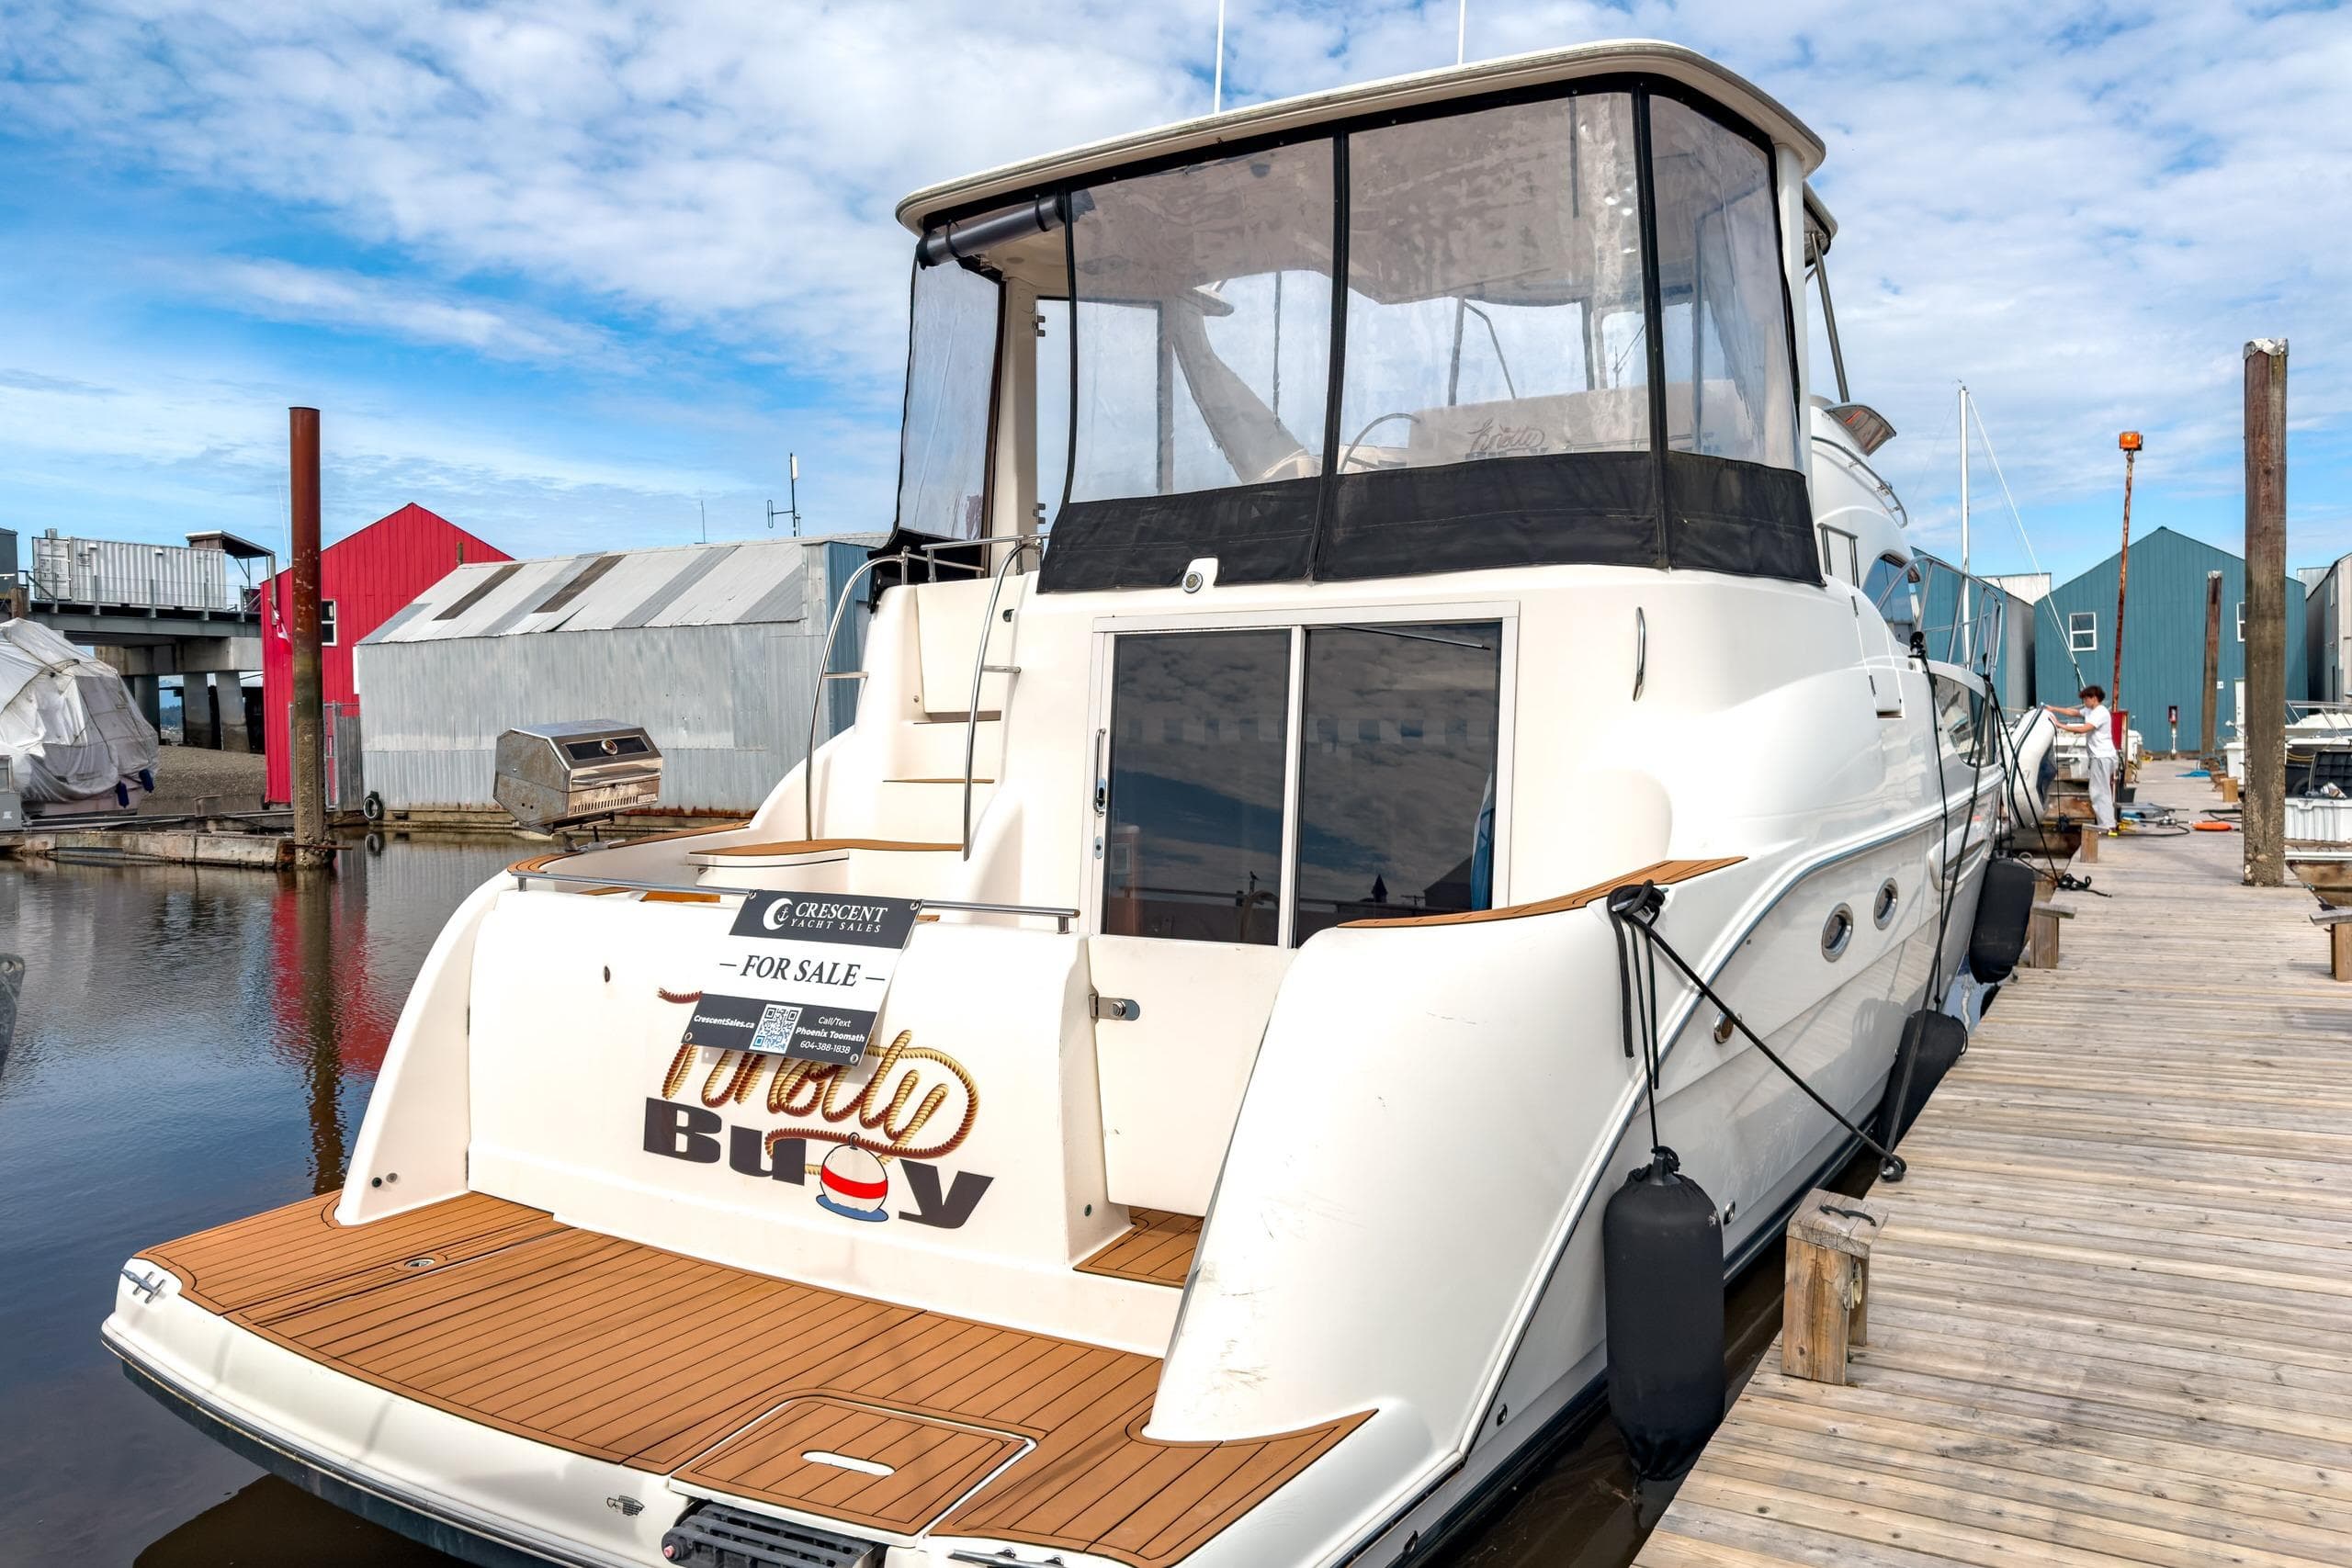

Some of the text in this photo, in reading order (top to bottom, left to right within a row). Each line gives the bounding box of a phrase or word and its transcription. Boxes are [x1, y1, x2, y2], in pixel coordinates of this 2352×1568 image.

[795, 901, 888, 923] CRESCENT
[790, 919, 882, 933] YACHT SALES
[740, 954, 862, 987] FOR SALE
[694, 1014, 755, 1030] CrescentSales.ca
[818, 1016, 852, 1028] Call/Text
[795, 1026, 865, 1043] Phoenix Toomath
[799, 1040, 852, 1054] 604-388-1838
